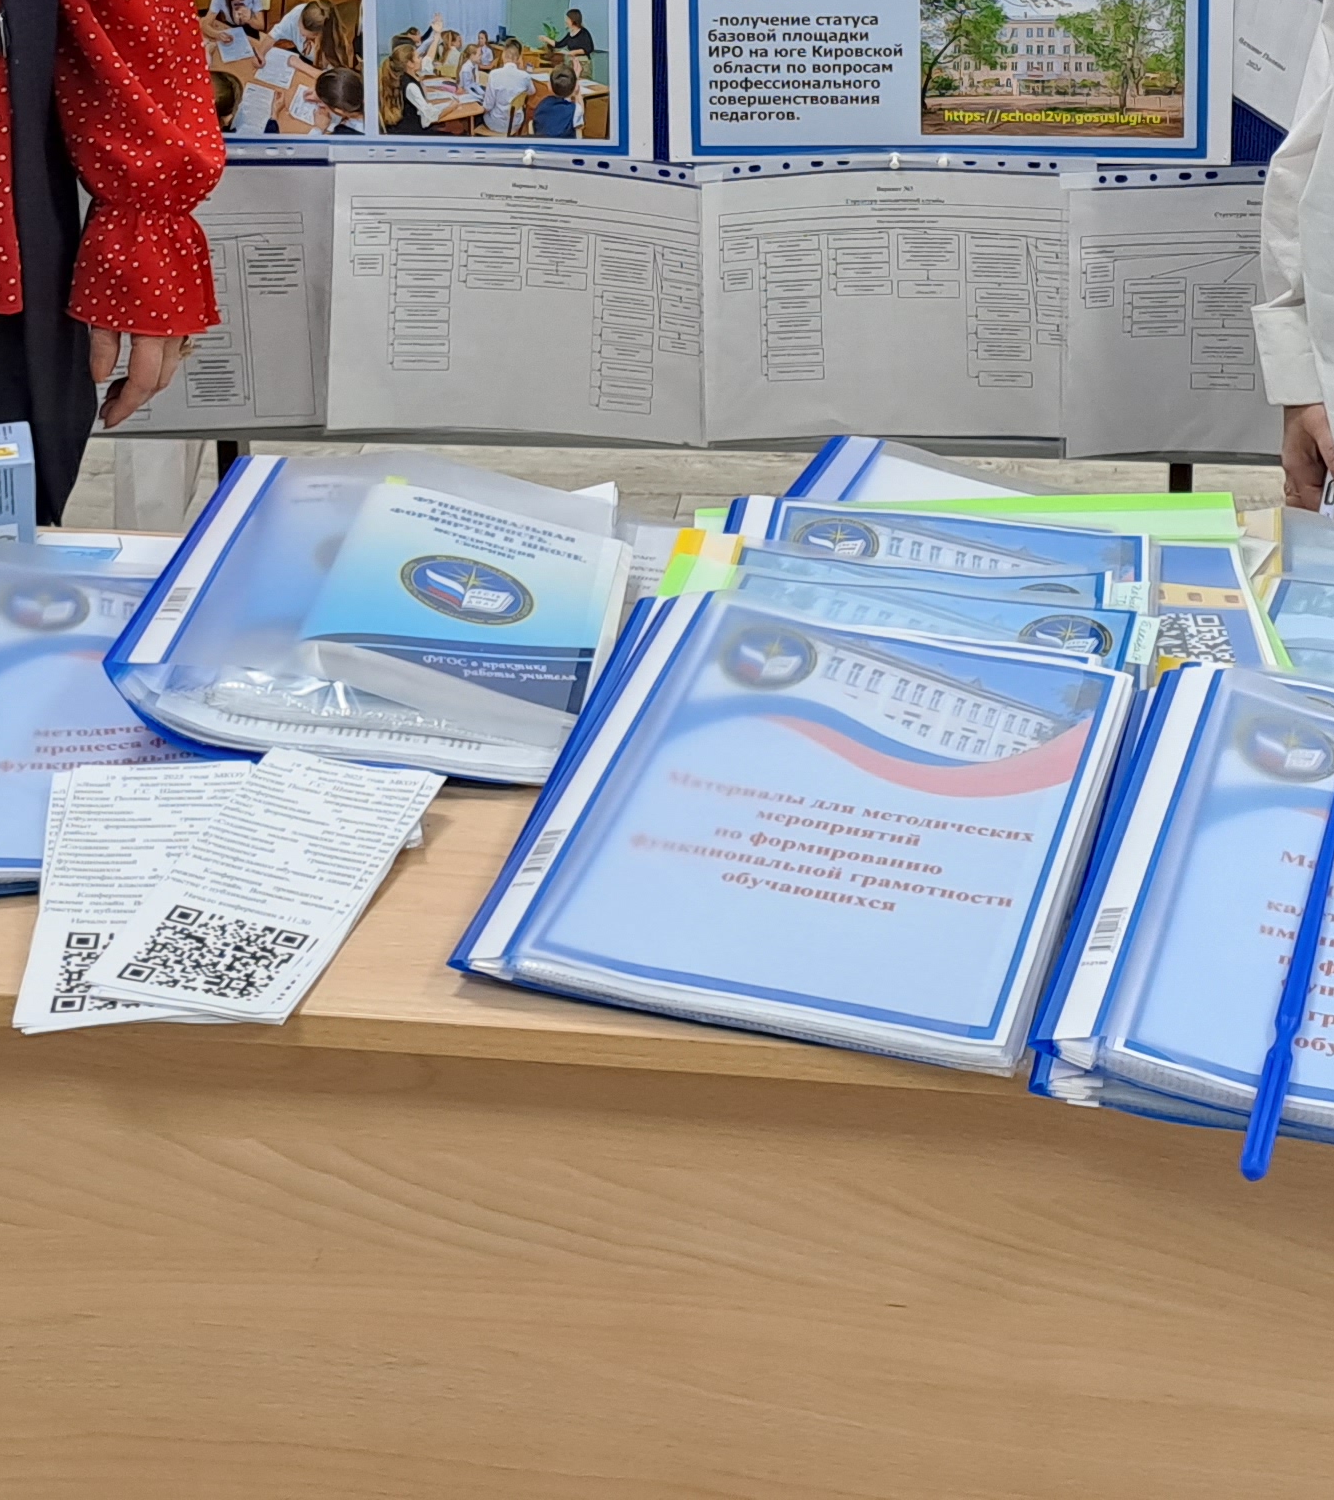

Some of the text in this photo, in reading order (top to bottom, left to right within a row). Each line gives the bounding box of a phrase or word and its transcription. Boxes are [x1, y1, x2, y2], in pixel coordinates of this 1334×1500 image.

[756, 809, 922, 848] мероприятий
[862, 807, 1034, 844] методических
[749, 831, 943, 876] формированию
[721, 870, 896, 913] обучающихся
